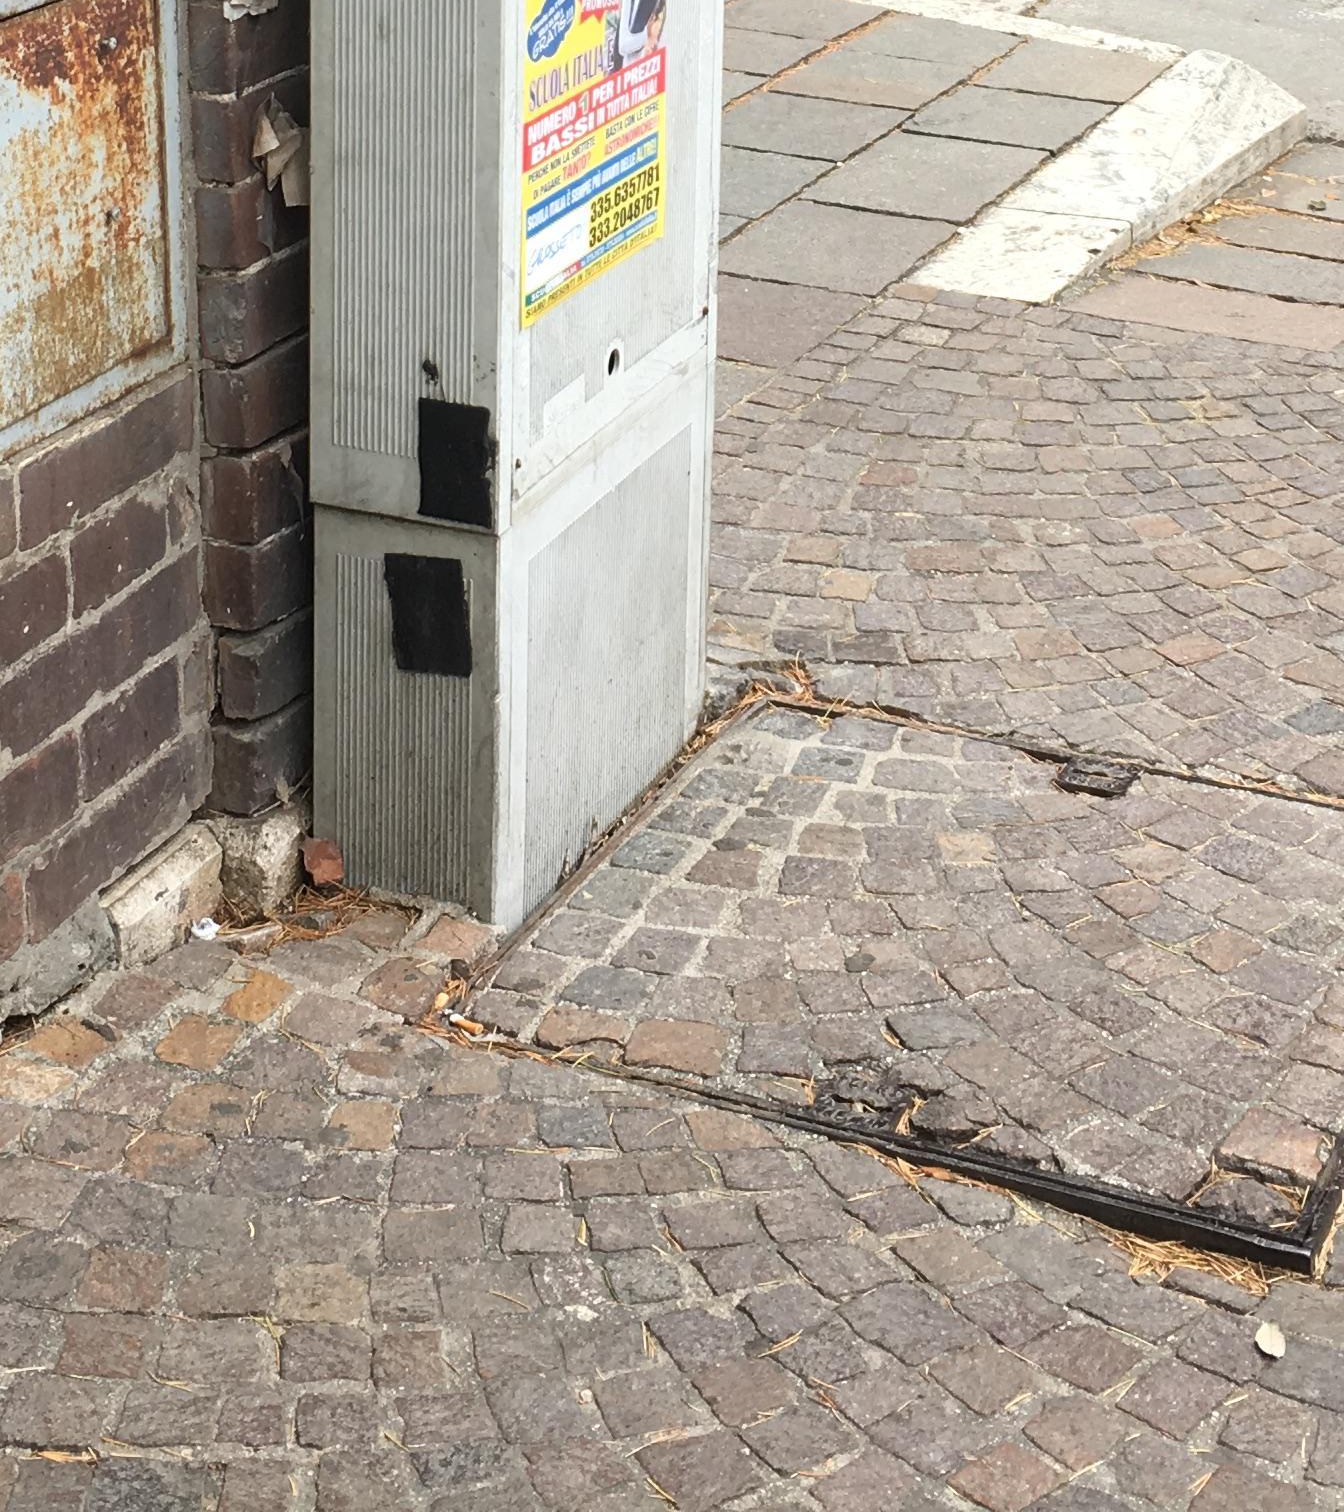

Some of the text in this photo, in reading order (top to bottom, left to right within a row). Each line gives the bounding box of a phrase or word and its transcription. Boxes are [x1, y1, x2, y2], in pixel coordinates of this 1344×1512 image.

[528, 54, 661, 146] NUMERO 1 PER I PREZZI
[529, 62, 569, 112] SCUOLA
[573, 44, 604, 87] ITALIA
[530, 111, 595, 165] BASSI
[607, 92, 630, 121] TUTTA
[589, 162, 660, 223] 335.6357781
[589, 187, 660, 248] 333.2048767
